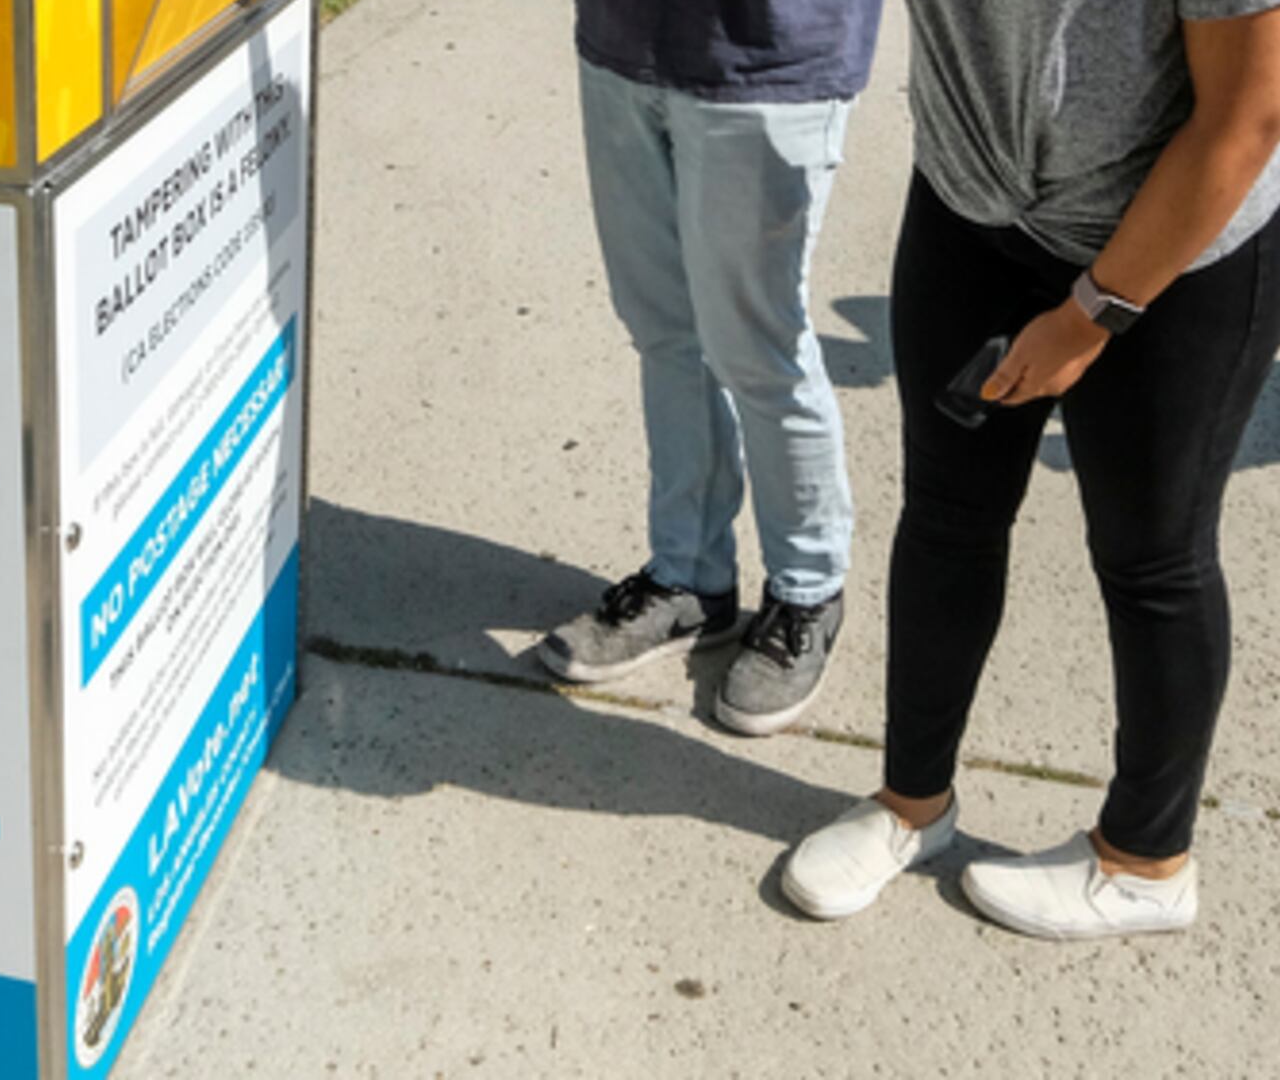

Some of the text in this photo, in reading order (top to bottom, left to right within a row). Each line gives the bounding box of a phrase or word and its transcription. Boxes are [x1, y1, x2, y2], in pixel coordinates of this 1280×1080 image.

[109, 140, 212, 261] TAMPERING
[95, 232, 170, 337] BALLOT
[171, 202, 209, 259] BOX
[90, 583, 125, 650] NO
[128, 458, 211, 598] POSTAGE
